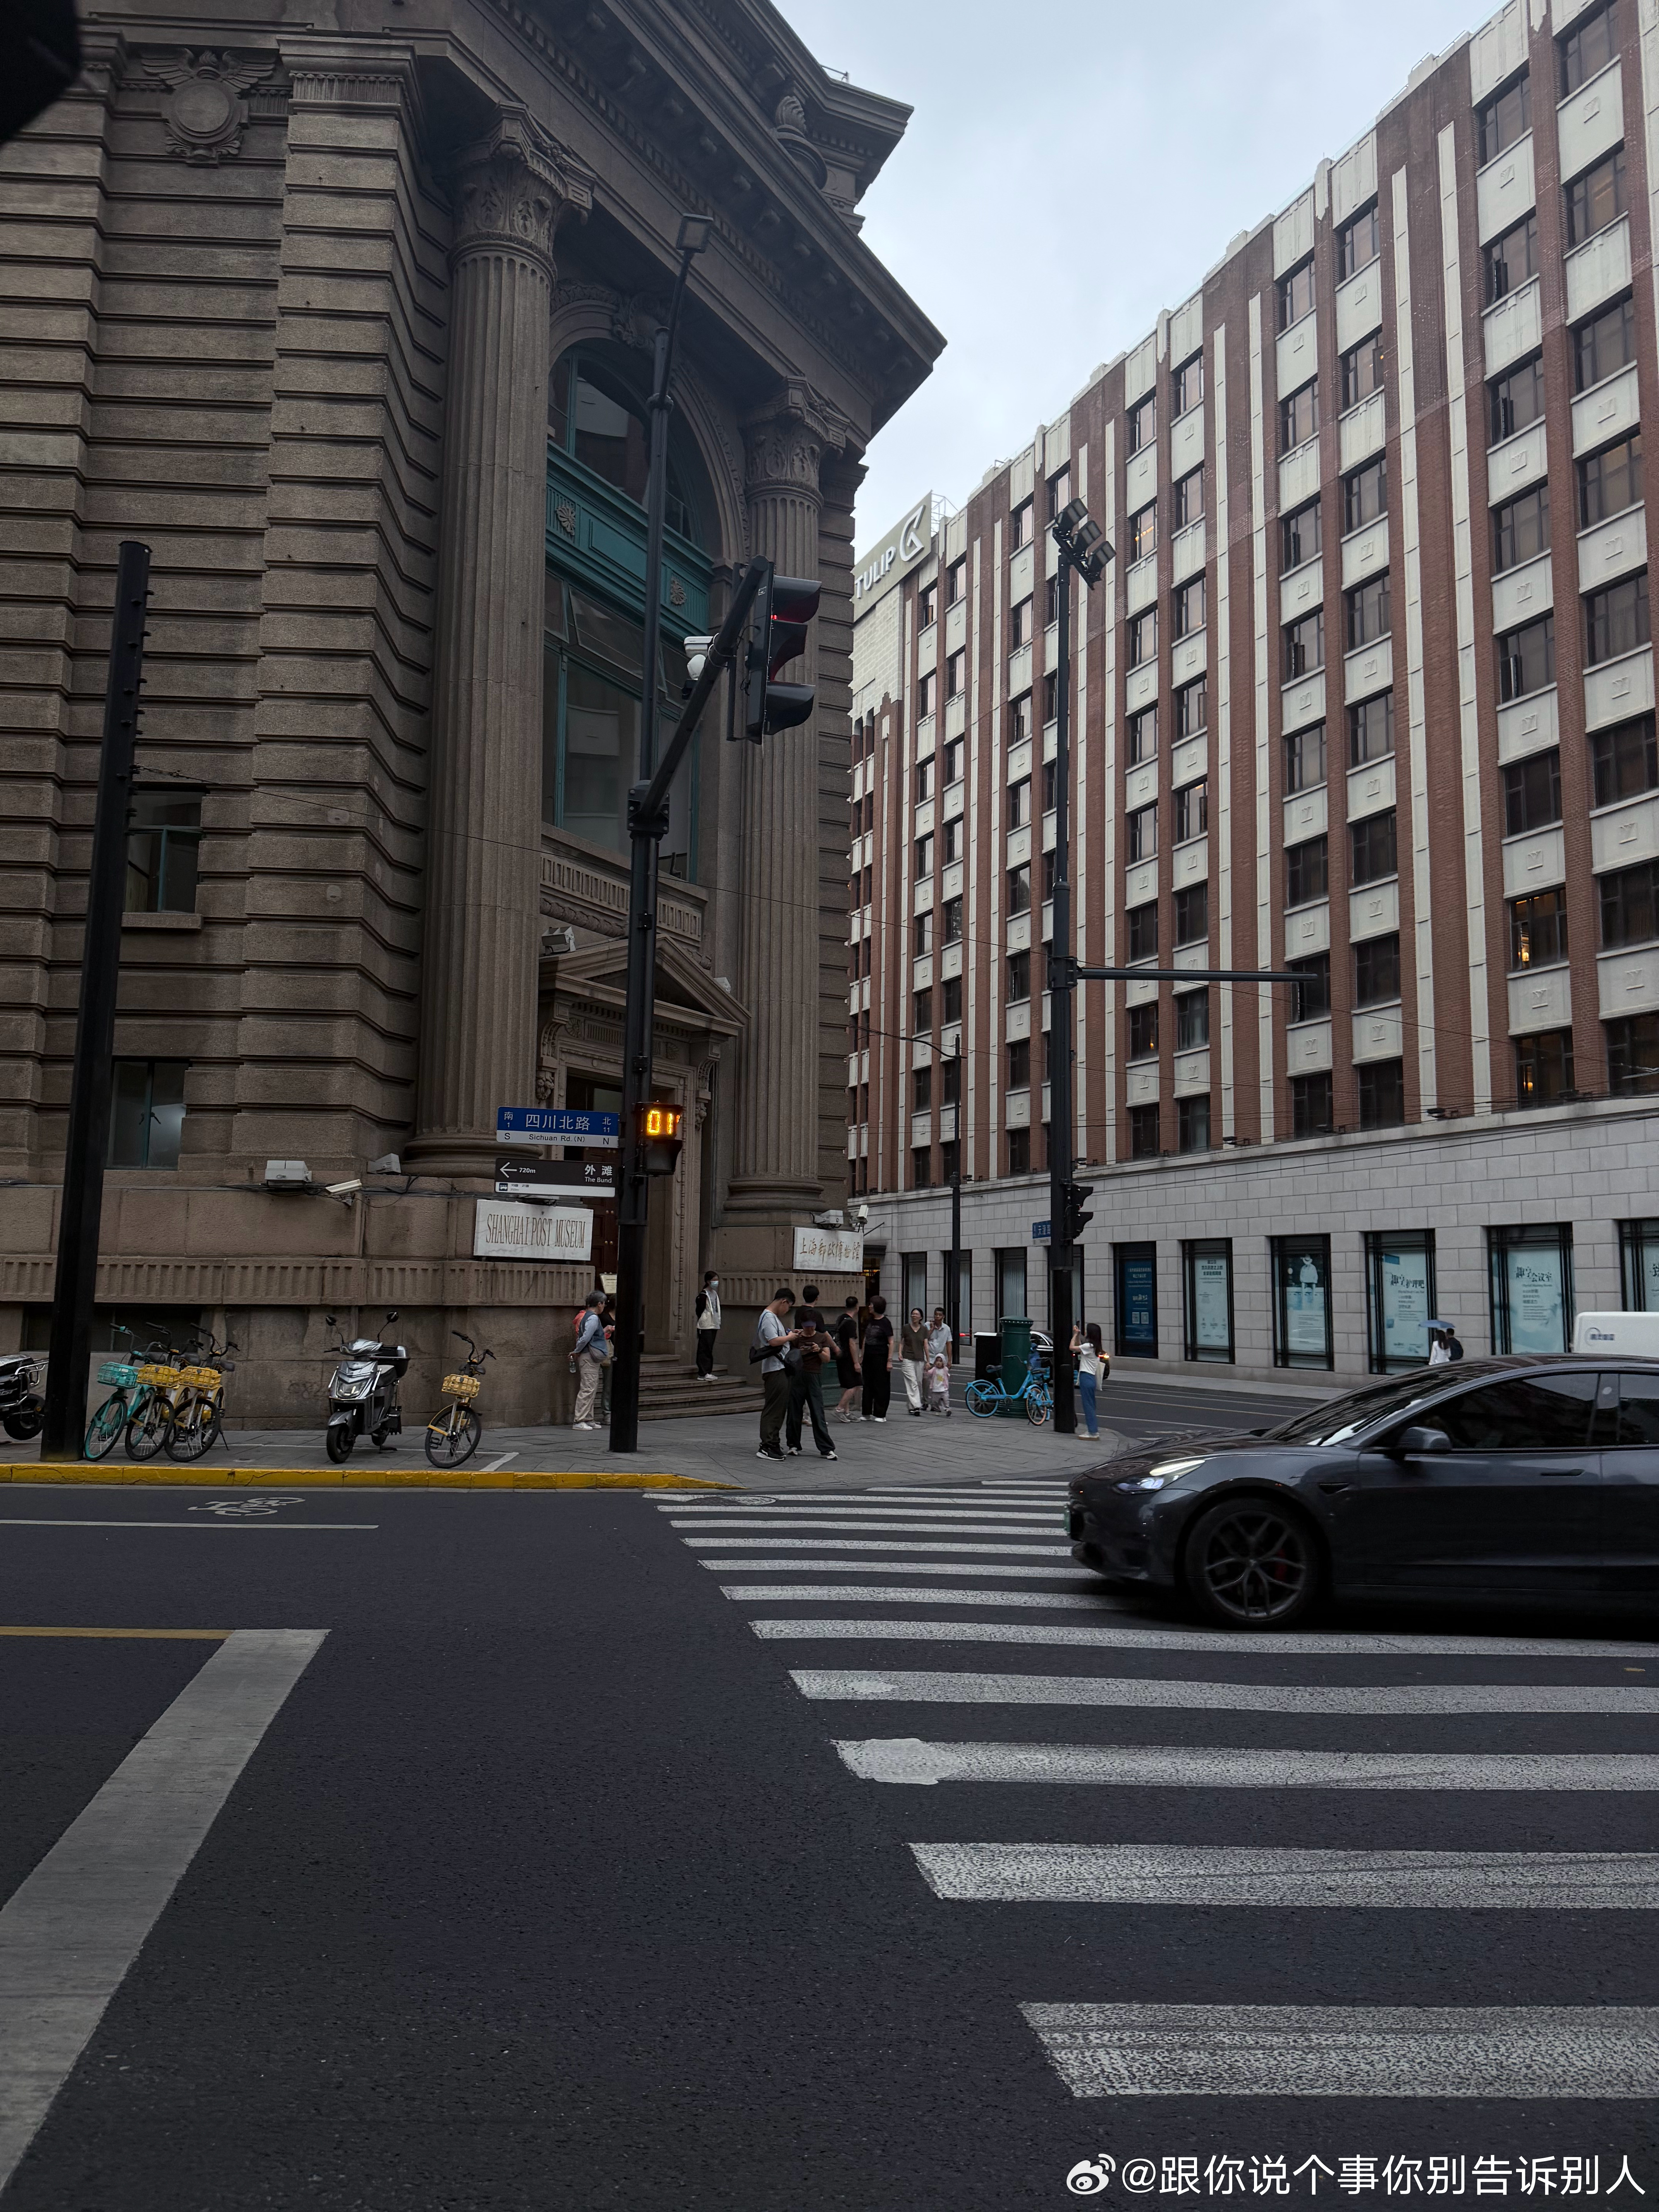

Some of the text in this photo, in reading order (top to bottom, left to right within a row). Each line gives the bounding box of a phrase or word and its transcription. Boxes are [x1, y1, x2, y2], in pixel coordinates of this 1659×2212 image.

[854, 546, 896, 599] TULIP
[504, 1111, 611, 1131] 南 四川北路 北
[647, 1110, 673, 1134] 01
[585, 1164, 613, 1176] 外滩
[486, 1214, 586, 1248] SHANGHAI POST MUSEUM
